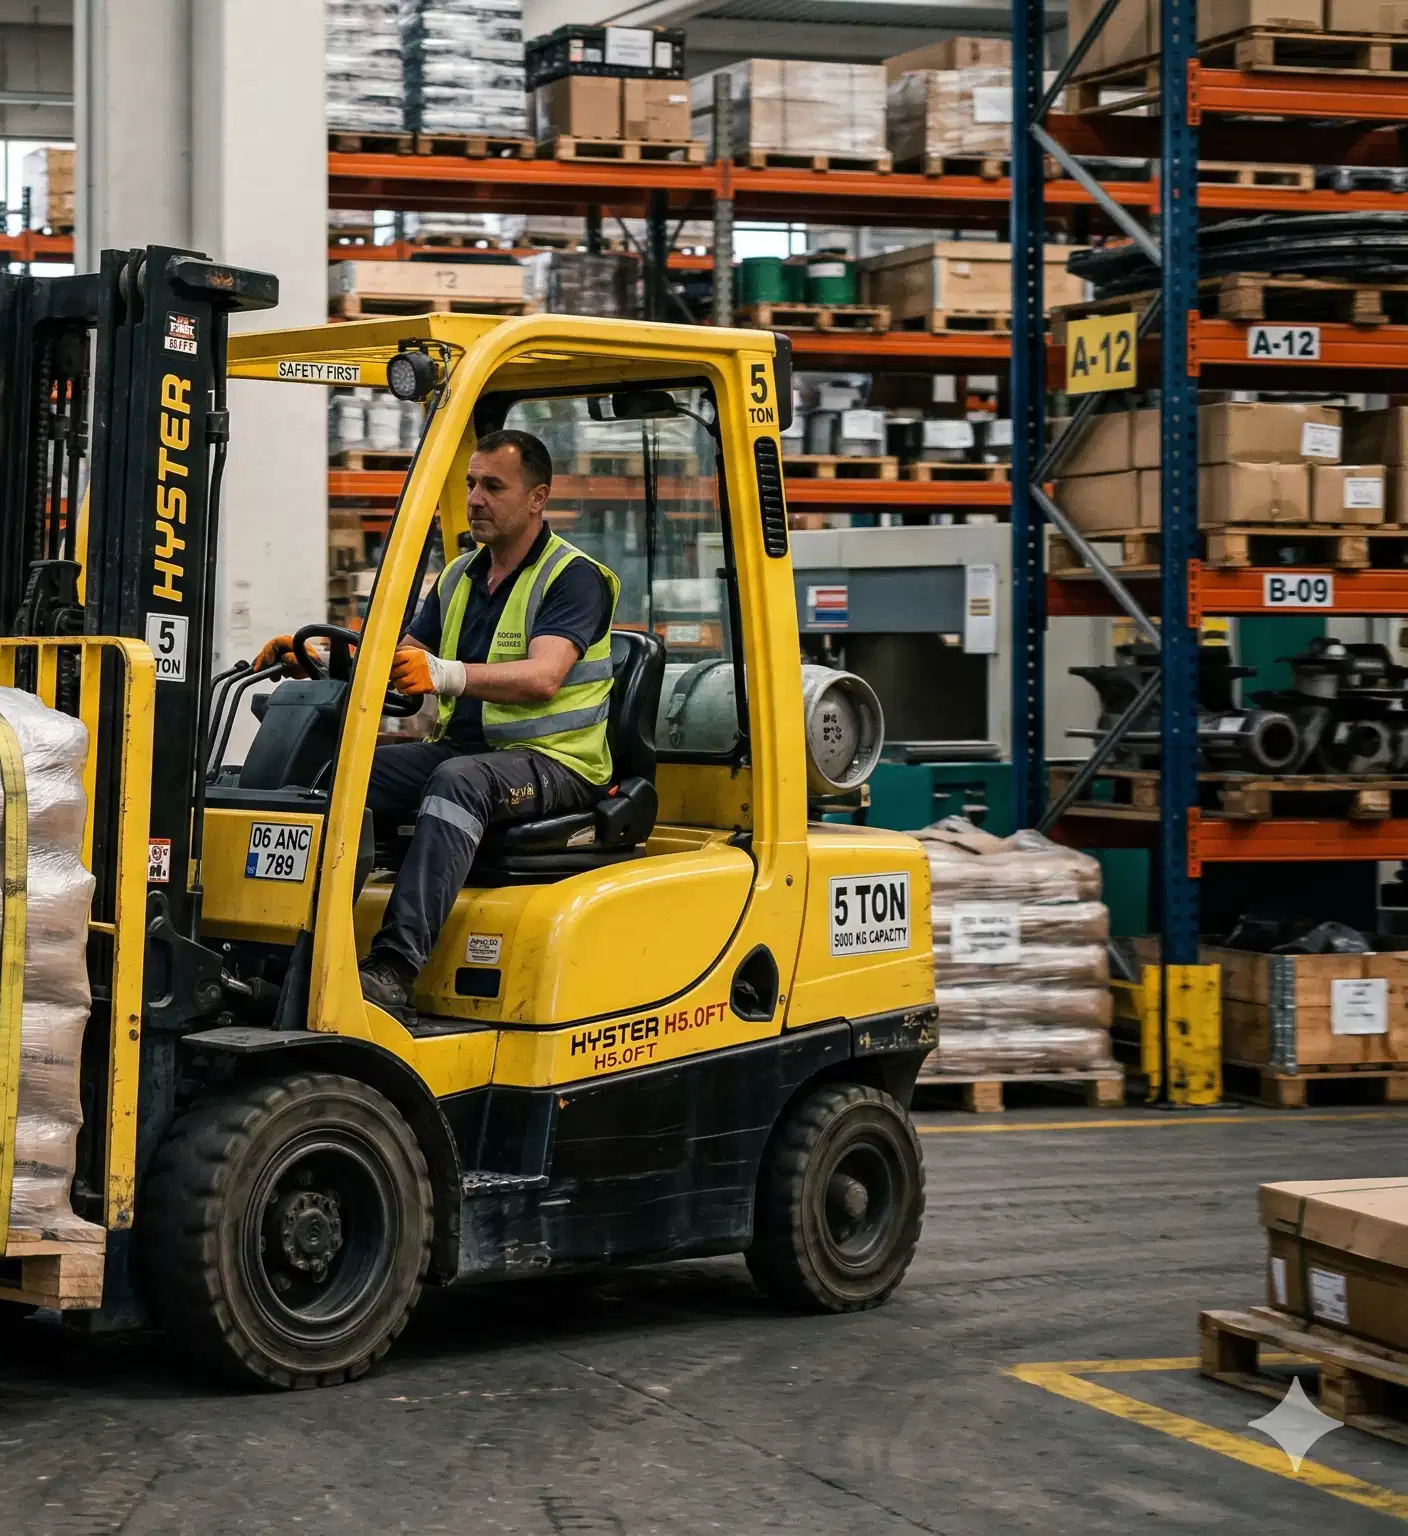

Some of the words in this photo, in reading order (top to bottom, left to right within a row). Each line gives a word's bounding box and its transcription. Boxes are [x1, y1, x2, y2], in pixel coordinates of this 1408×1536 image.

[1072, 330, 1131, 377] A-12
[1252, 330, 1314, 355] A-12
[279, 362, 323, 379] SAFETY
[327, 365, 359, 381] FIRST
[750, 364, 768, 404] 5
[748, 407, 774, 423] TON
[152, 373, 192, 603] HYSTER
[1270, 578, 1328, 602] B-09
[158, 620, 175, 654] 5
[154, 657, 180, 674] TON
[252, 826, 272, 849] 06
[274, 828, 309, 851] ANC
[264, 854, 295, 876] 789
[834, 886, 849, 927] 5
[855, 882, 906, 925] TON
[834, 932, 854, 948] 5000
[571, 1016, 659, 1056] HYSTER
[664, 1001, 728, 1036] H5.0FT
[594, 1042, 657, 1071] H5.0FT
